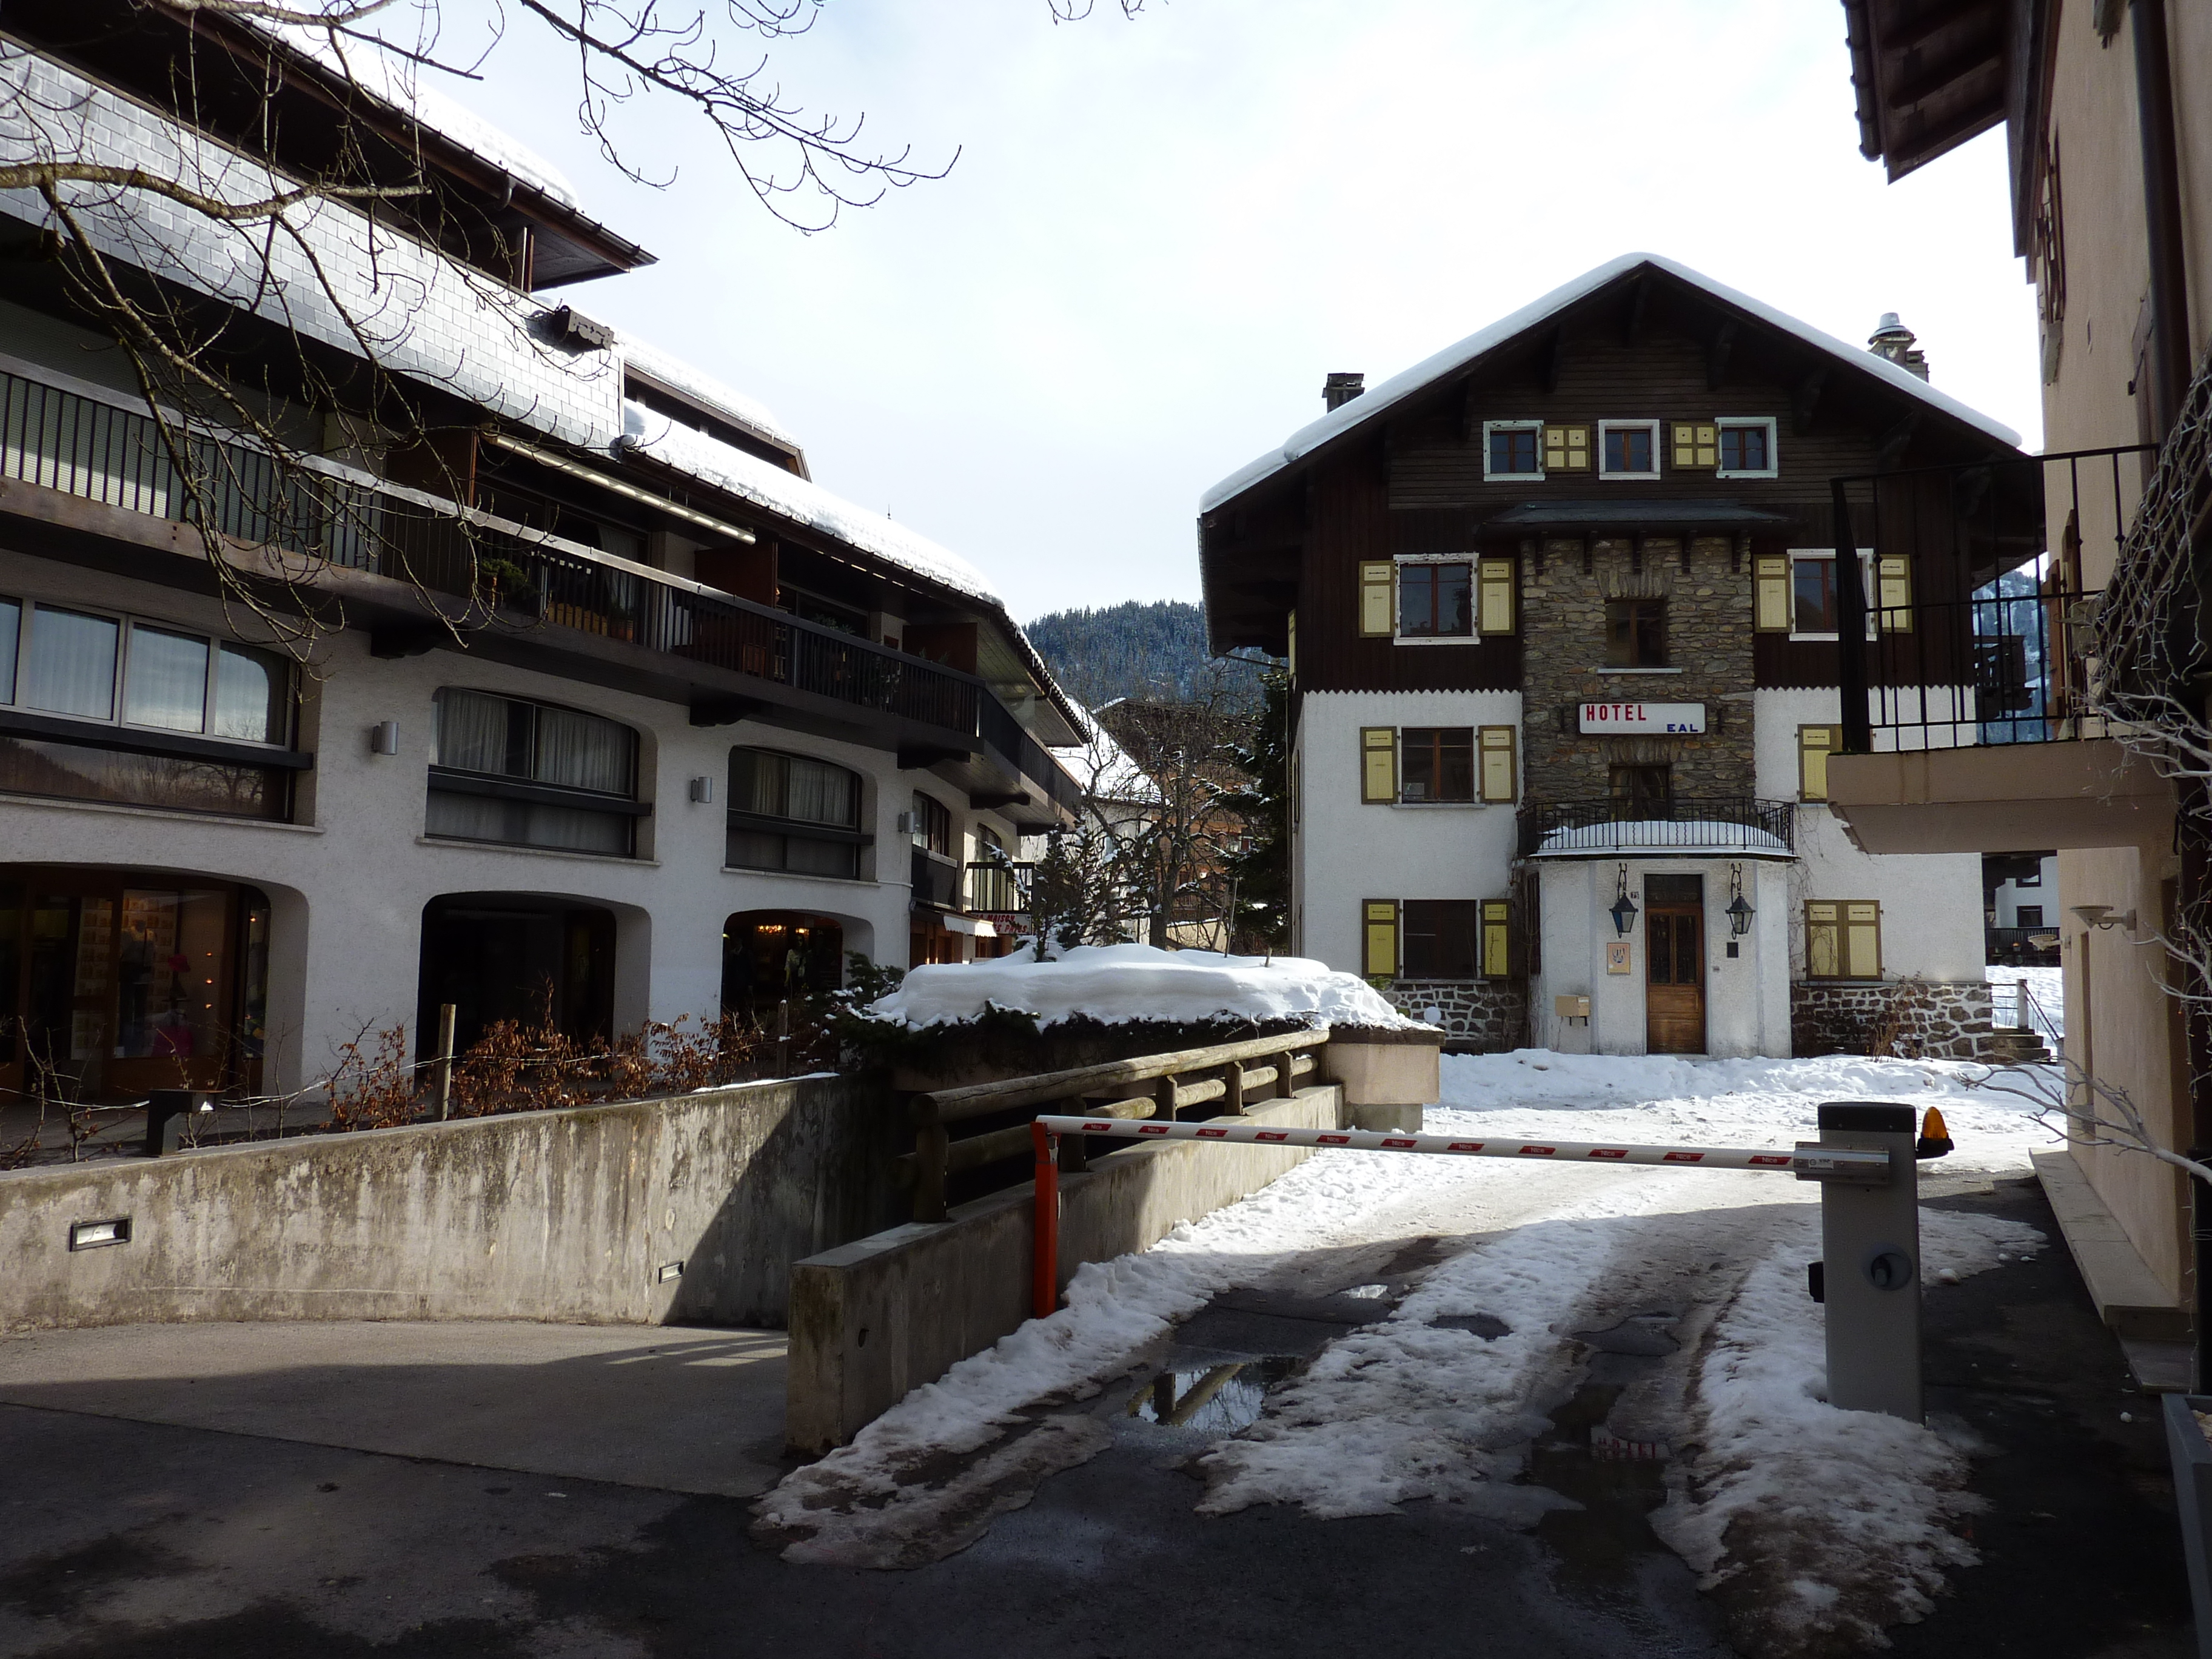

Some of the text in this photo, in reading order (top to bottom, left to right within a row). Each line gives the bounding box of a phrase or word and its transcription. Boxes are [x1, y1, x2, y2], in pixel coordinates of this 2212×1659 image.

[1586, 705, 1647, 722] HOTEL
[1667, 723, 1698, 732] EAL
[987, 914, 1015, 922] MAISON
